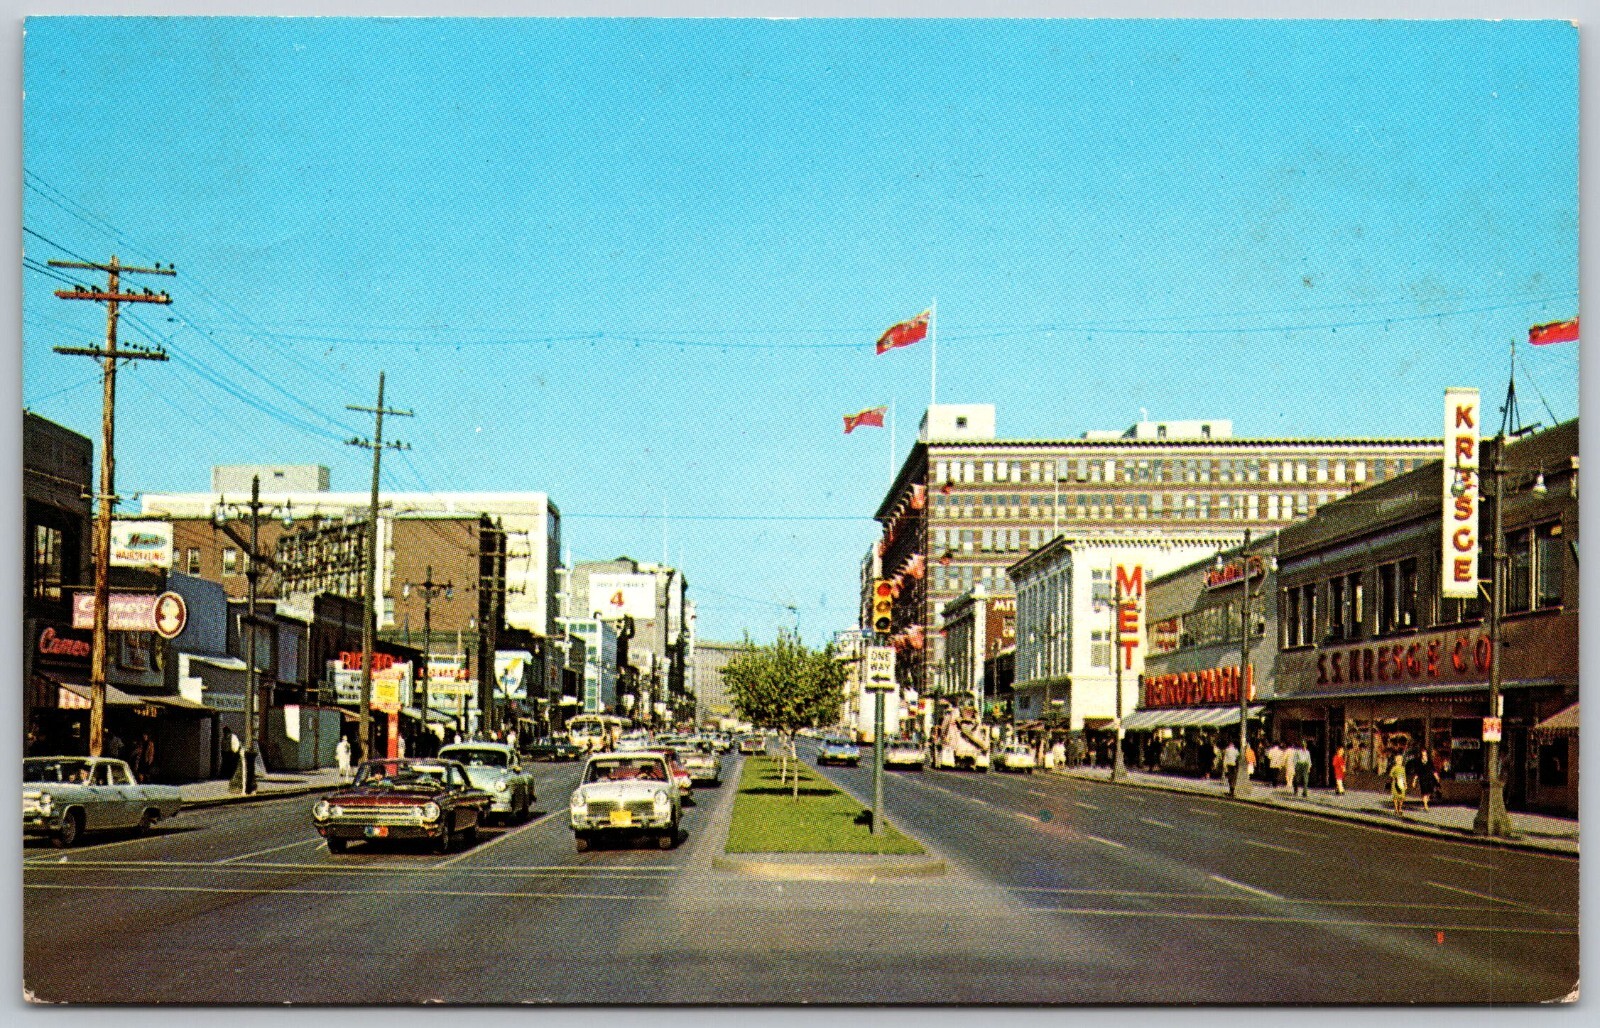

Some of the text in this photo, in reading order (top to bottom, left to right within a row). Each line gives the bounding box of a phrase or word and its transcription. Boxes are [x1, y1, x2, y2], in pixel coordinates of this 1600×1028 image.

[610, 590, 625, 607] 4
[1116, 564, 1143, 670] MET
[39, 627, 90, 657] Cameo
[871, 651, 891, 661] ONE
[871, 662, 891, 671] WAY
